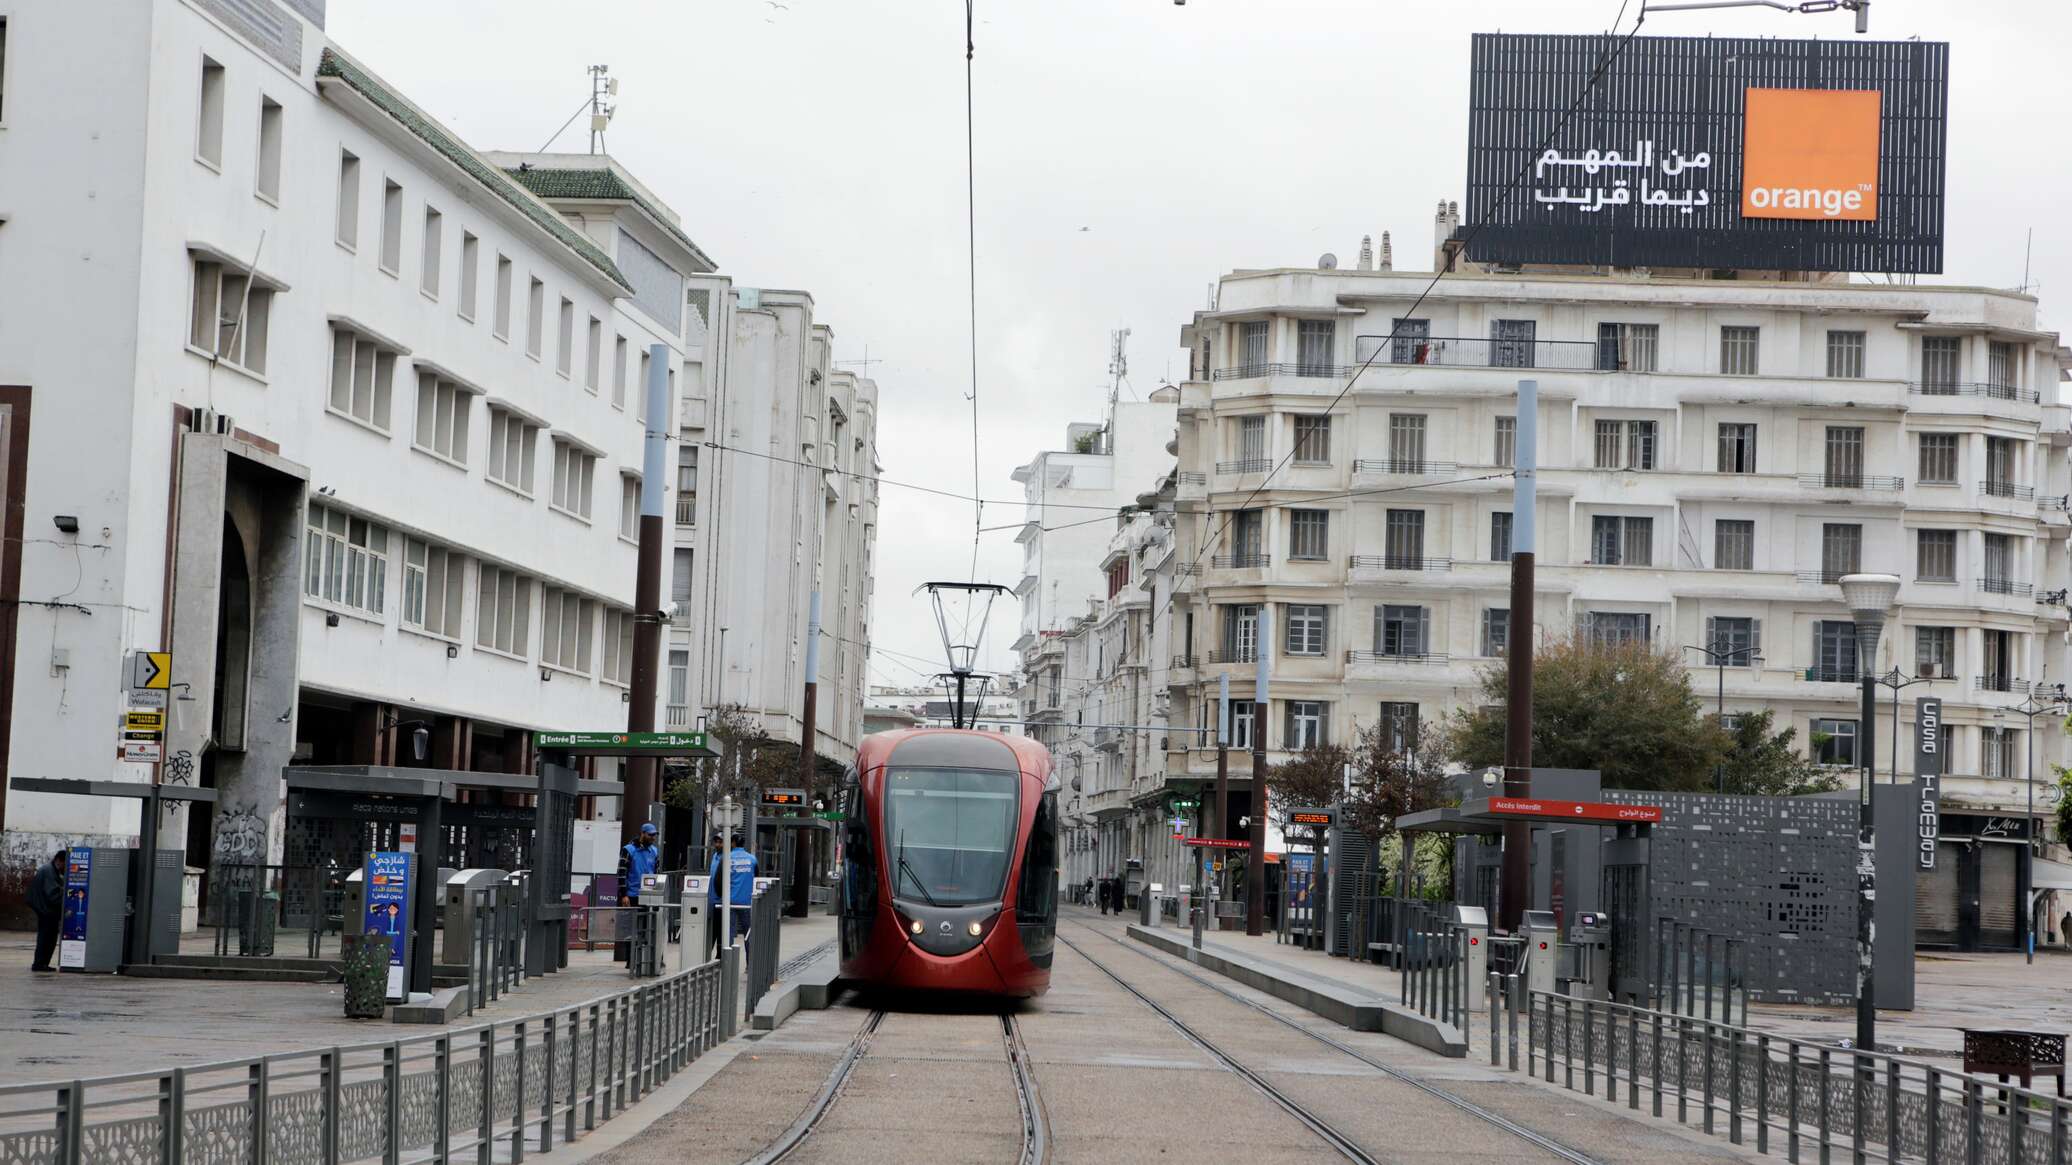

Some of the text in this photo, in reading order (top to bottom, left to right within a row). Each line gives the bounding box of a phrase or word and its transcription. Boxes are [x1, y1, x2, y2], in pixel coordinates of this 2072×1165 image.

[1535, 139, 1711, 179] من المهم
[1535, 177, 1710, 214] ديما قريب
[1750, 185, 1862, 216] orange
[132, 732, 155, 740] Change
[547, 735, 570, 744] Entrée
[1496, 801, 1516, 810] Accès
